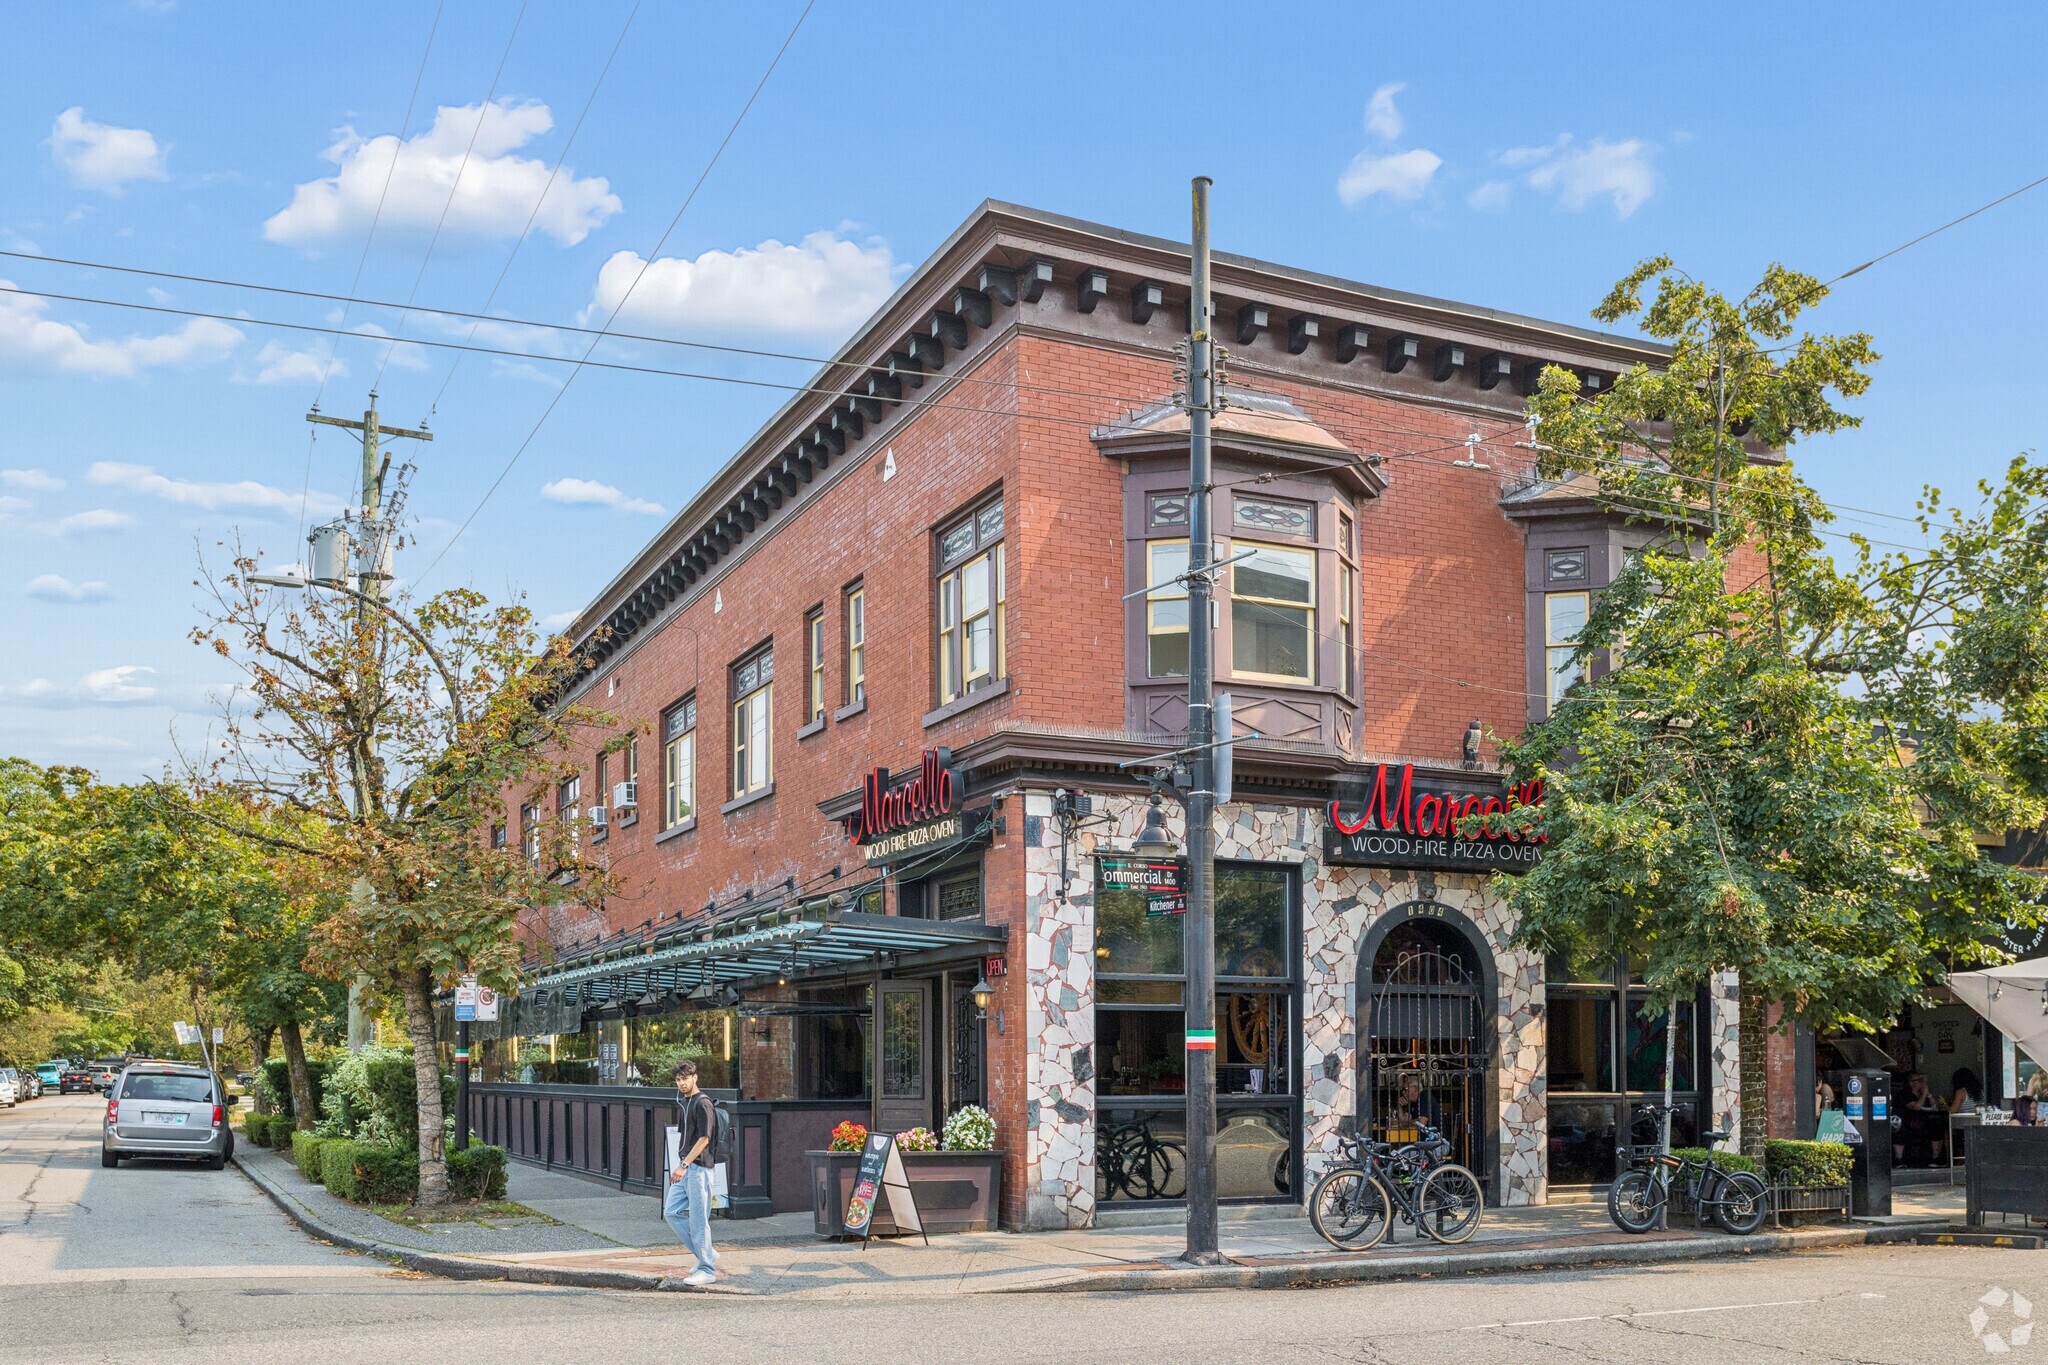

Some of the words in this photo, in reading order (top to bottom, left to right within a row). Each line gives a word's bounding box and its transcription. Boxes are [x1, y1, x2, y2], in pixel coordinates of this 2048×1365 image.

[848, 746, 952, 845] Marcello
[1332, 763, 1549, 843] Marcell
[864, 840, 889, 860] WOOD
[890, 833, 907, 853] FIRE
[908, 827, 929, 848] PIZZA
[930, 819, 955, 841] OVEN
[1351, 836, 1410, 855] WOOD
[1415, 839, 1447, 857] FIRE
[1453, 842, 1494, 860] PIZZA
[1499, 845, 1542, 861] OVEN
[1103, 869, 1162, 885] ommercial
[1149, 900, 1176, 911] Kitchener
[1407, 905, 1445, 917] 1404
[2000, 934, 2024, 954] YSTER
[2032, 926, 2046, 947] BAR
[986, 959, 1003, 976] OPEN
[1985, 1112, 2003, 1121] PLEASE
[1821, 1132, 1844, 1142] HAPP
